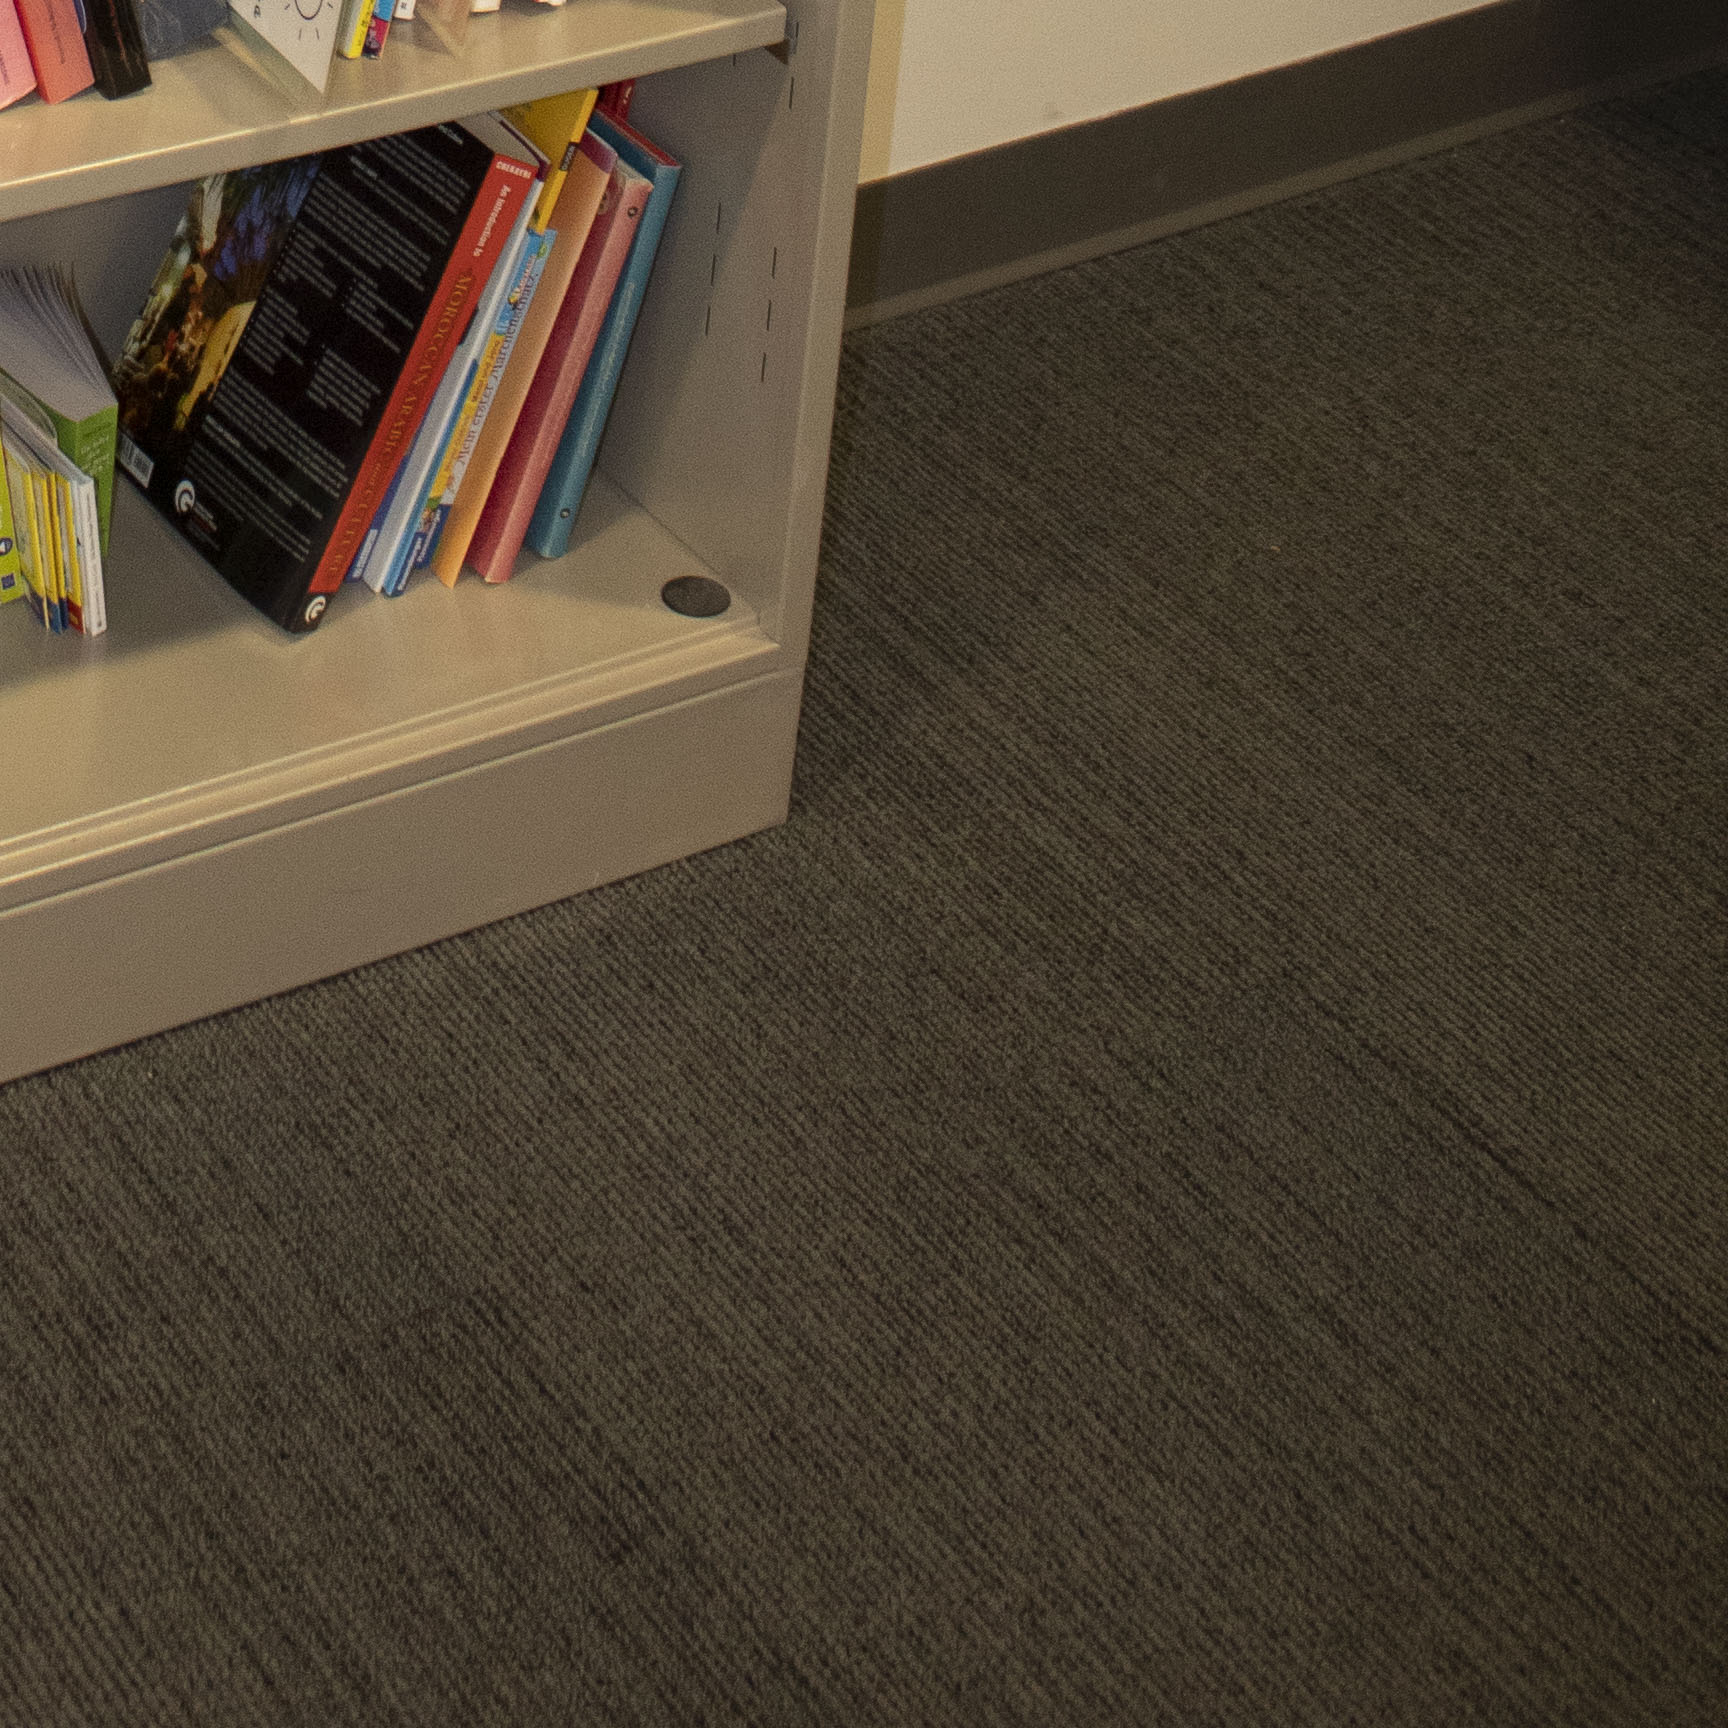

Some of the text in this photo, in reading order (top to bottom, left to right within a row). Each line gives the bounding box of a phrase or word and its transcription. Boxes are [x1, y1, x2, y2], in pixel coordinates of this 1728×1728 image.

[476, 184, 511, 248] An Introduction
[411, 270, 473, 389] MOROCCAN
[379, 391, 418, 459] ARABIC
[455, 382, 496, 466] Mein erster
